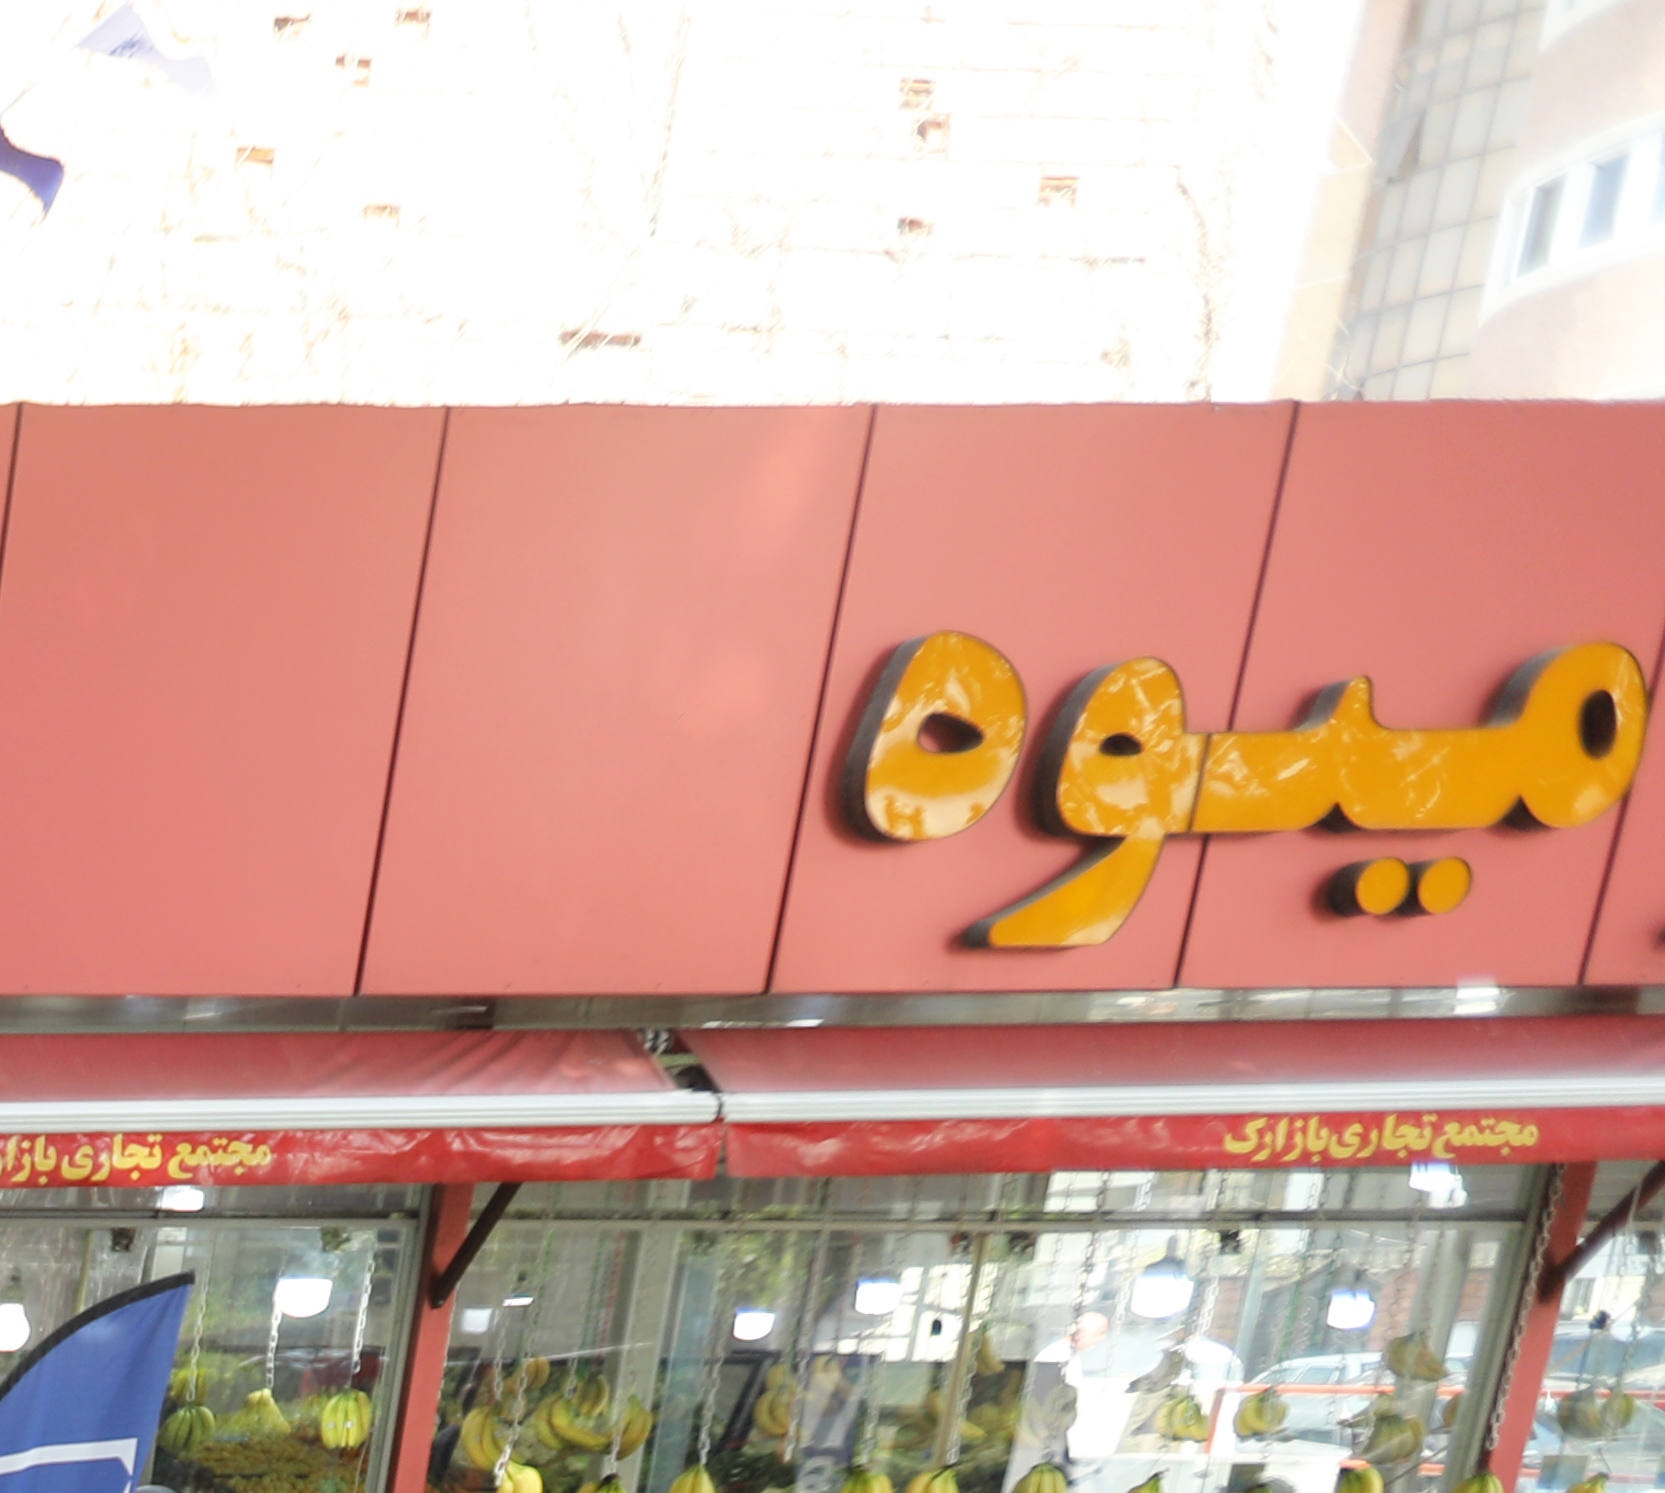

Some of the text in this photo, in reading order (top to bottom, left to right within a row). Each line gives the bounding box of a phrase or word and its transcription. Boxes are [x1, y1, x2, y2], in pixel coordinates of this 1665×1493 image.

[863, 628, 1650, 949] میوه
[60, 1132, 164, 1182] تجاری
[167, 1136, 273, 1180] مجتمع
[1223, 1113, 1540, 1164] مجتمع تجاری بازارک
